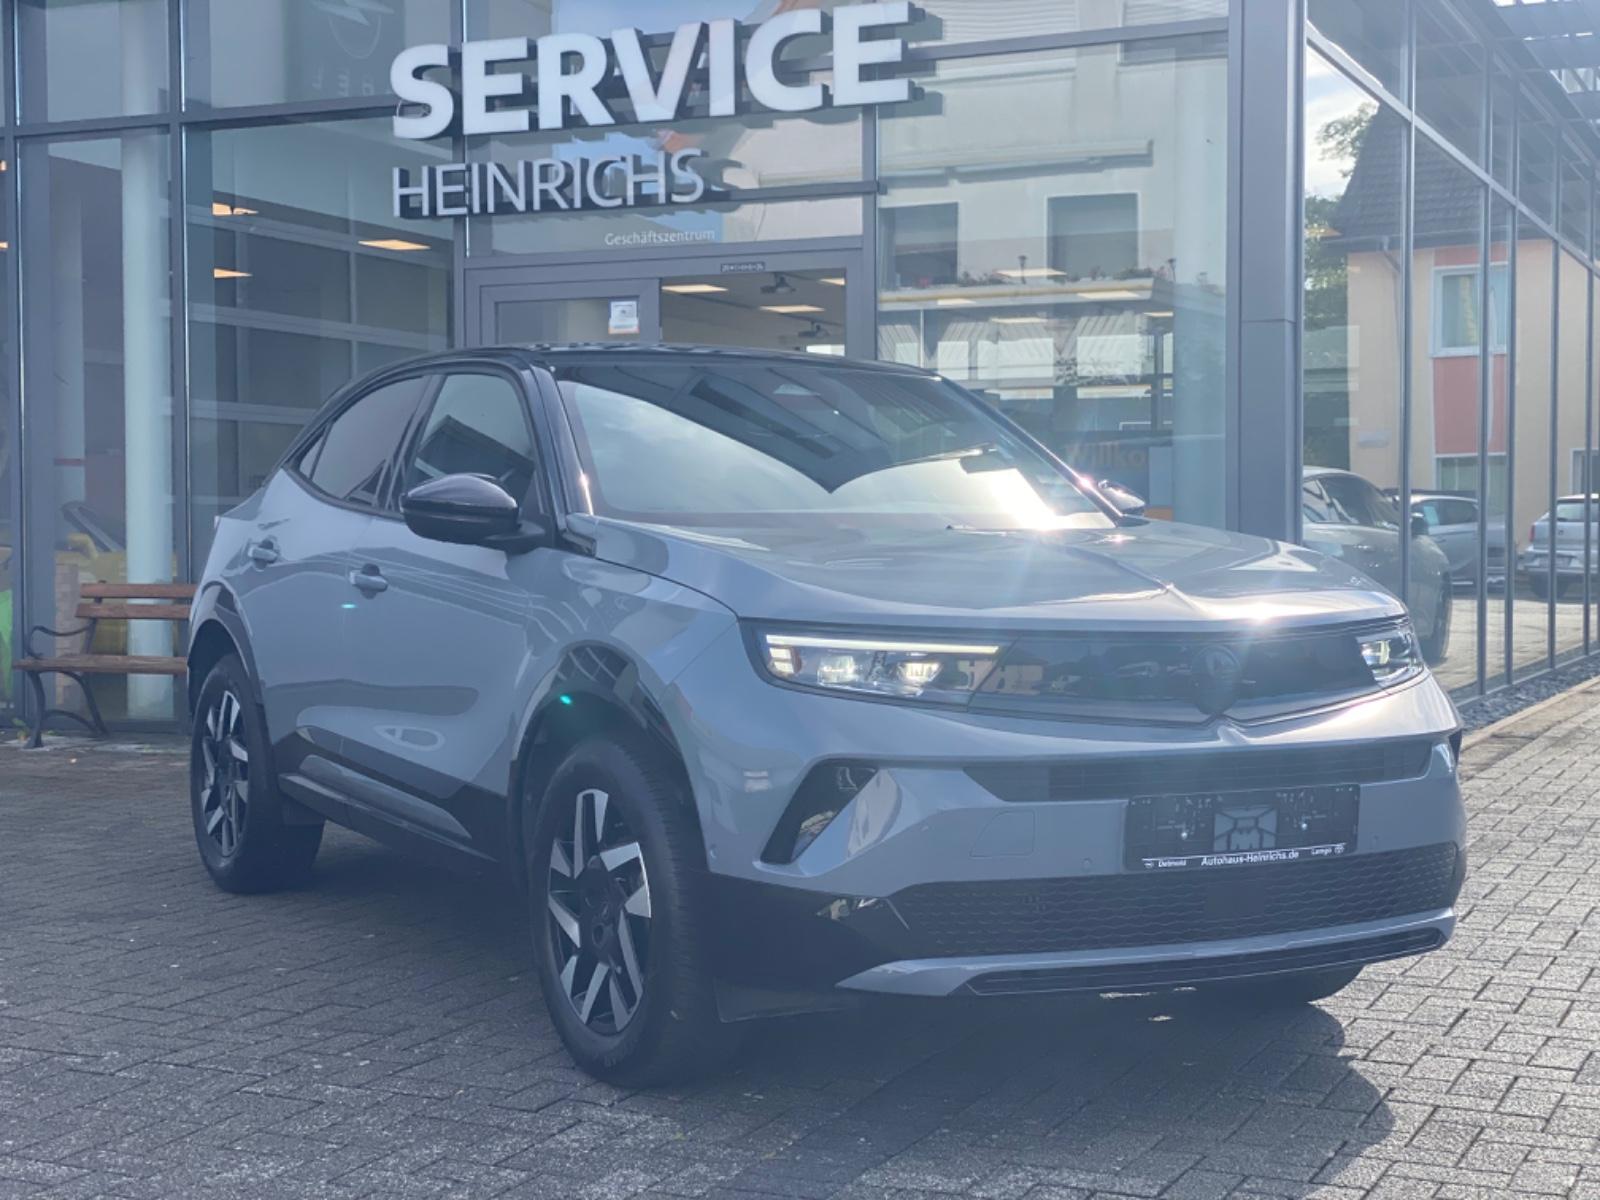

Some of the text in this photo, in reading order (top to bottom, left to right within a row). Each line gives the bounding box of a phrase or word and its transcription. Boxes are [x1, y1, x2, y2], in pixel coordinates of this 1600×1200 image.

[389, 3, 911, 140] SERVICE
[392, 148, 704, 217] HEINRICHS
[603, 229, 716, 246] Geschäftszentrum
[1201, 850, 1299, 867] Autohaus-Heinrichs.de
